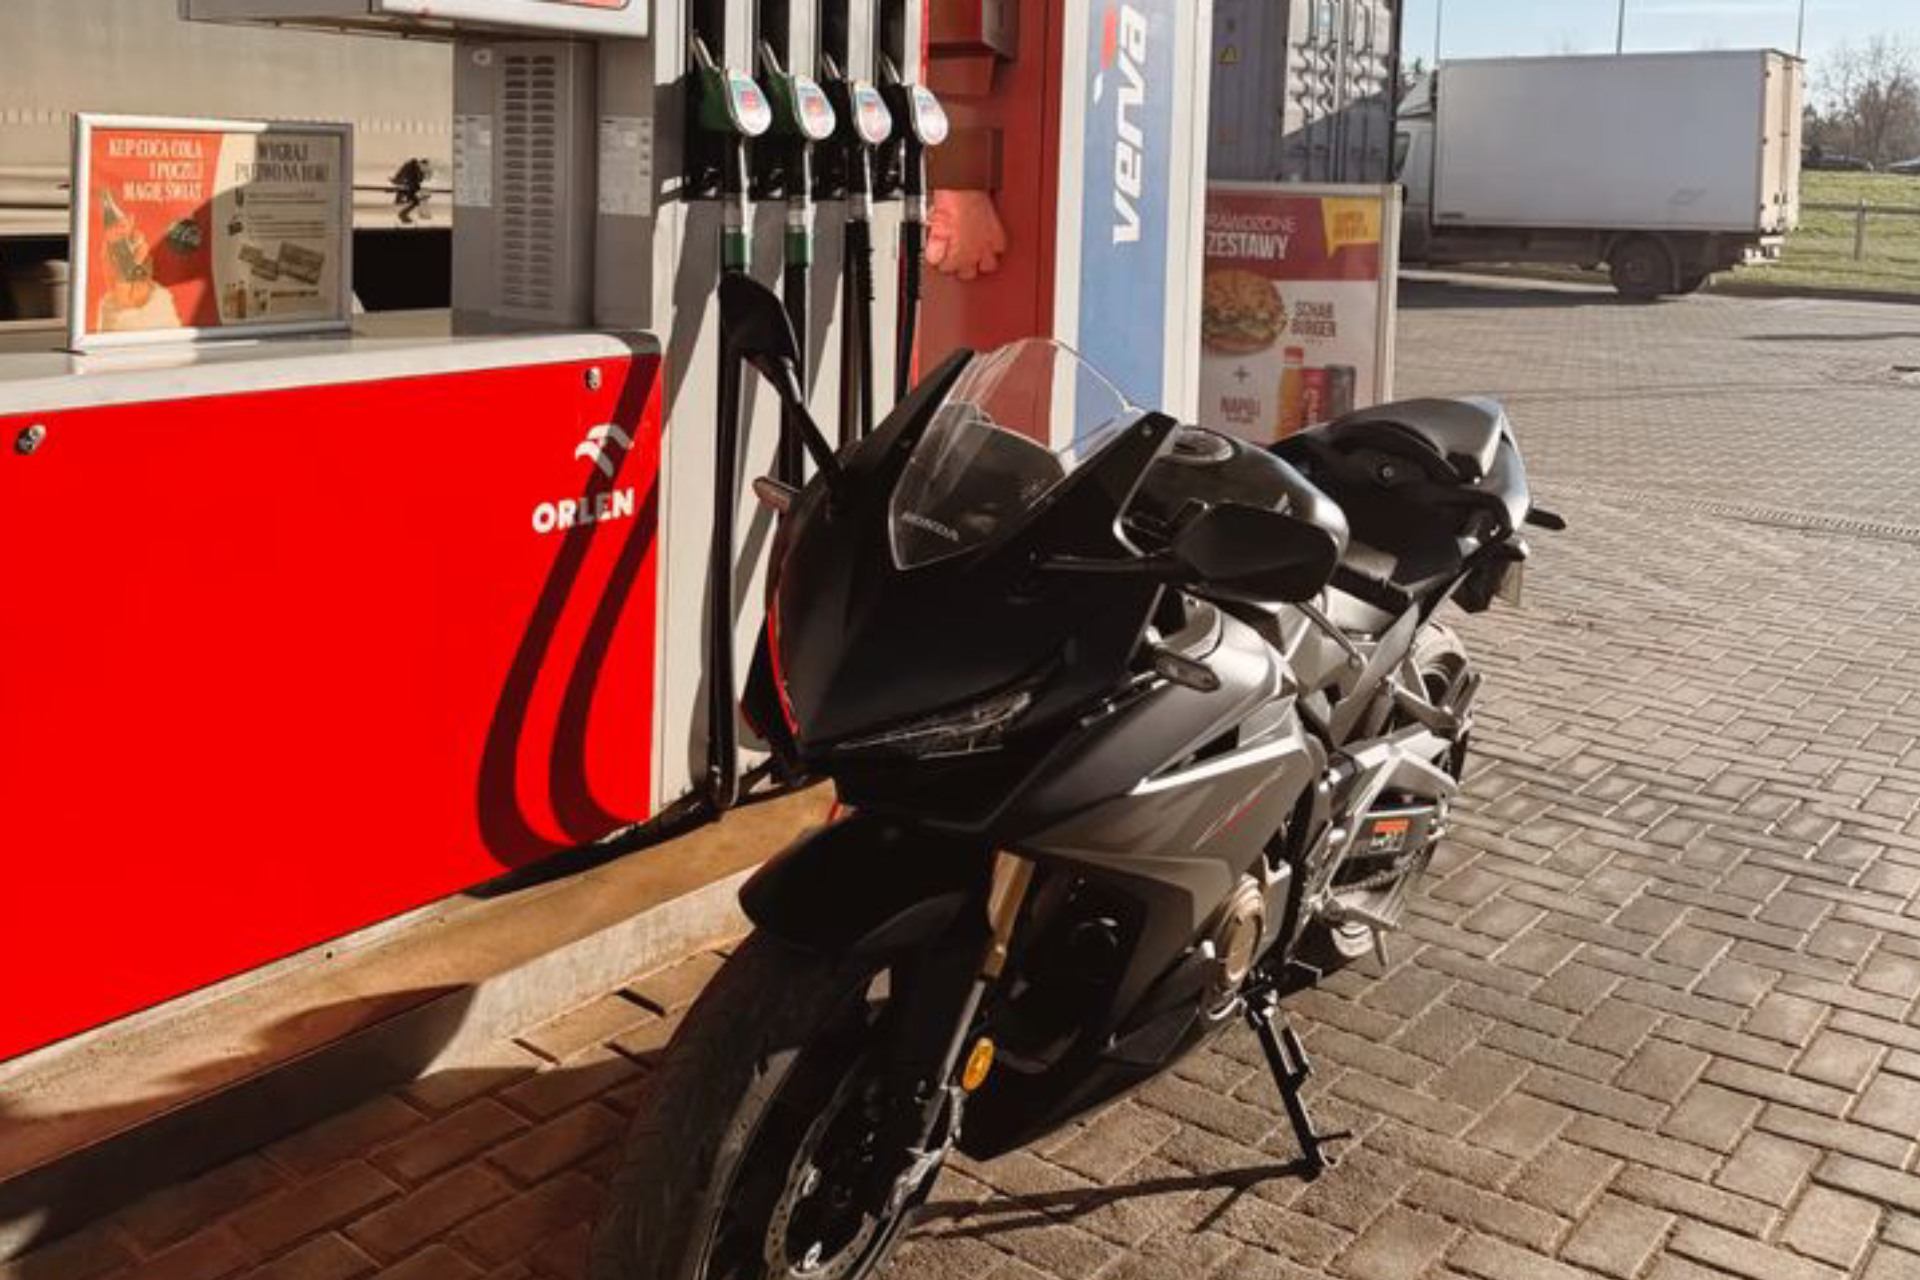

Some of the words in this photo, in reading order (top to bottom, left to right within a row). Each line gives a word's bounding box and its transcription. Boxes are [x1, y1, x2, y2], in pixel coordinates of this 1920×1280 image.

[1112, 4, 1147, 245] verva
[1206, 231, 1288, 259] ZESTAWY
[532, 488, 634, 534] ORLEN
